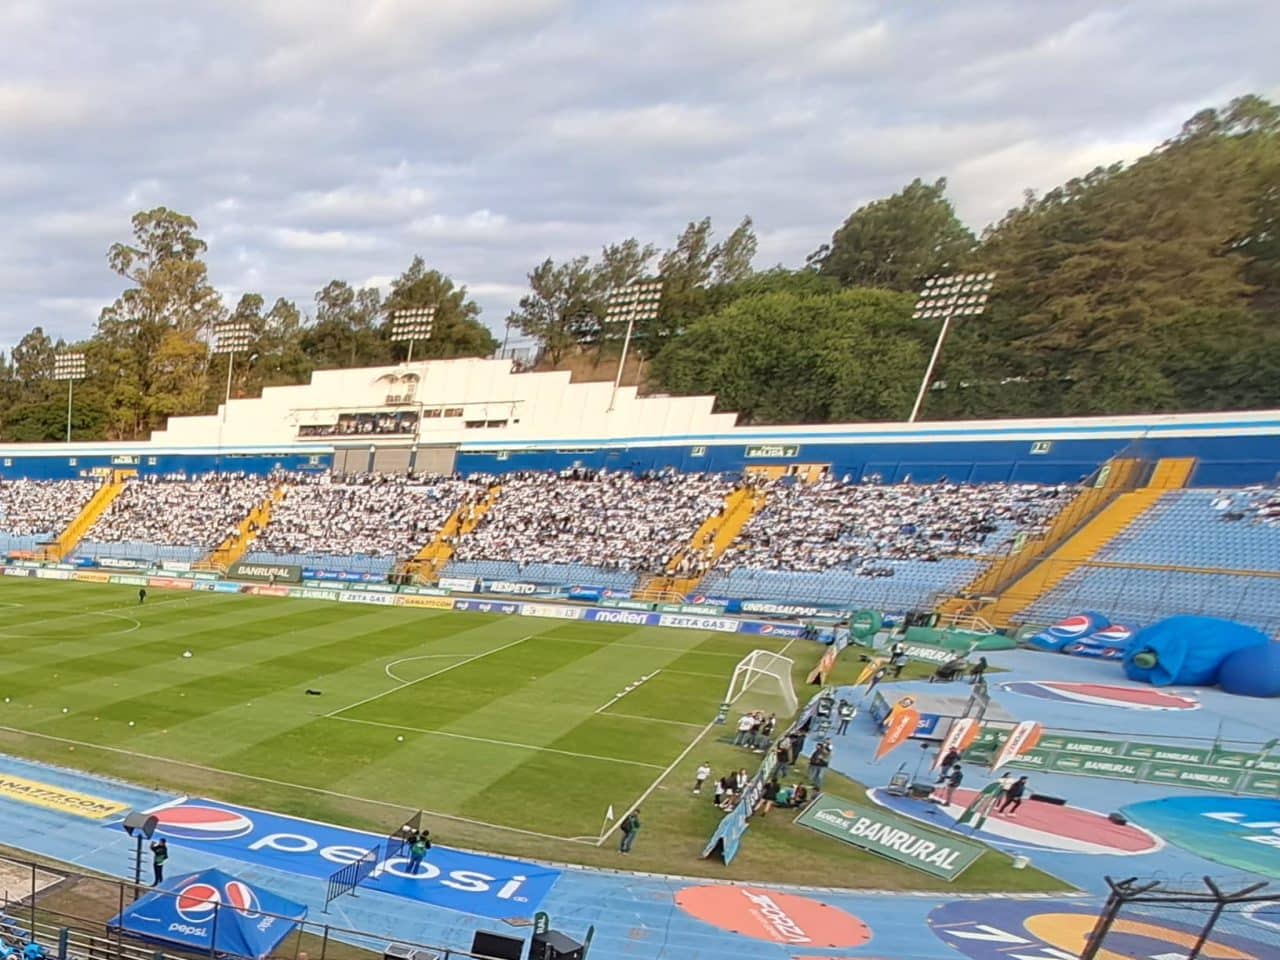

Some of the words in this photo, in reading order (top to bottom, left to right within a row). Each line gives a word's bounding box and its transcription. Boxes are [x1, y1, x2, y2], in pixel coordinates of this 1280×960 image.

[749, 448, 784, 457] SALIDA
[238, 566, 290, 577] BANRURAL
[490, 581, 537, 594] RESPETO
[595, 611, 648, 624] molten
[671, 617, 698, 626] ZETA
[703, 619, 724, 628] GAS
[771, 627, 799, 637] pepsi
[1066, 743, 1115, 755] BANRURAL
[1155, 751, 1200, 763] BANRURAL
[1083, 760, 1136, 774] BANRURAL
[1180, 771, 1231, 784] BANRURAL
[849, 817, 961, 870] BANRURAL
[248, 833, 528, 901] pepsi
[168, 922, 208, 937] pepsi
